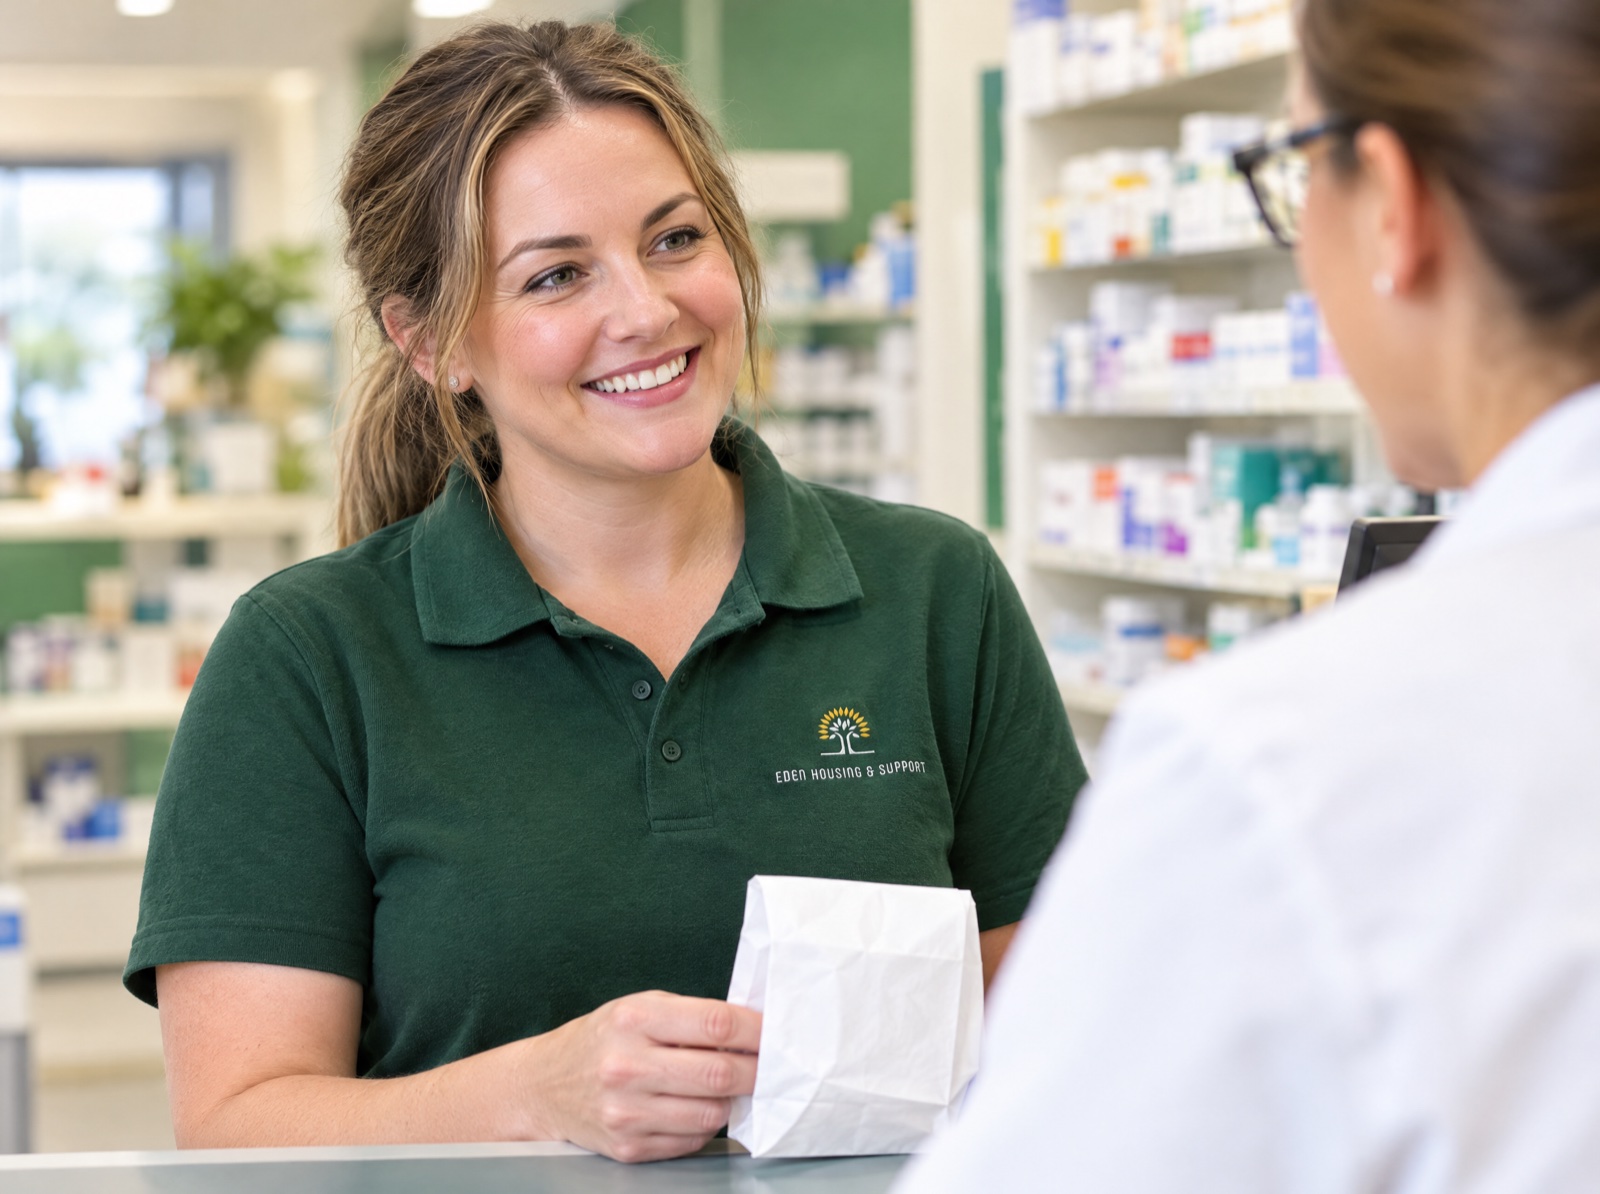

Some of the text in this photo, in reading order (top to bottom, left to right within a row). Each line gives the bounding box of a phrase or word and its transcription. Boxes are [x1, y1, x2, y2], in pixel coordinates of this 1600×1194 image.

[775, 760, 926, 783] EDEN HOUSING & SUPPORT
